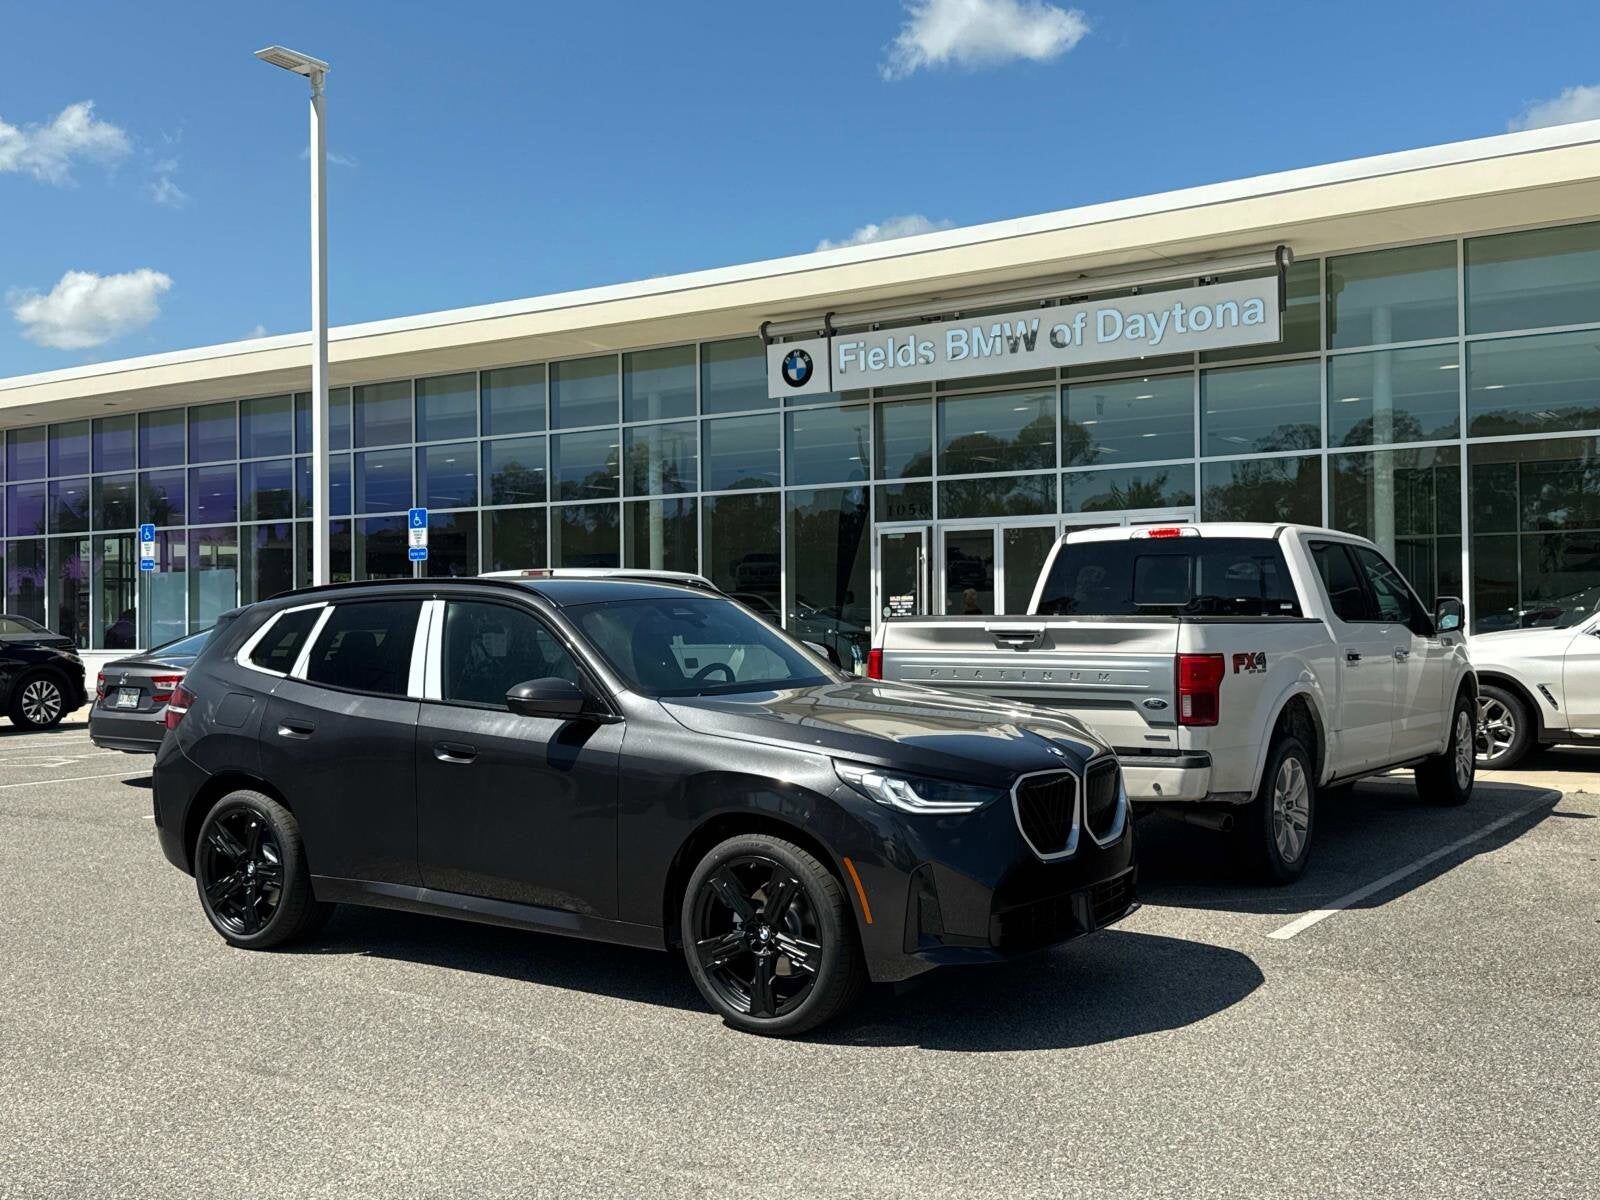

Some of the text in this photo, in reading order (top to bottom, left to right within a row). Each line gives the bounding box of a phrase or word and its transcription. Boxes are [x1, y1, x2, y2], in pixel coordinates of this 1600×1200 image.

[838, 297, 1265, 374] Fields BMW of Daytona
[888, 503, 929, 517] 1050
[1232, 652, 1267, 674] FX4
[929, 668, 1112, 682] PLATINUM
